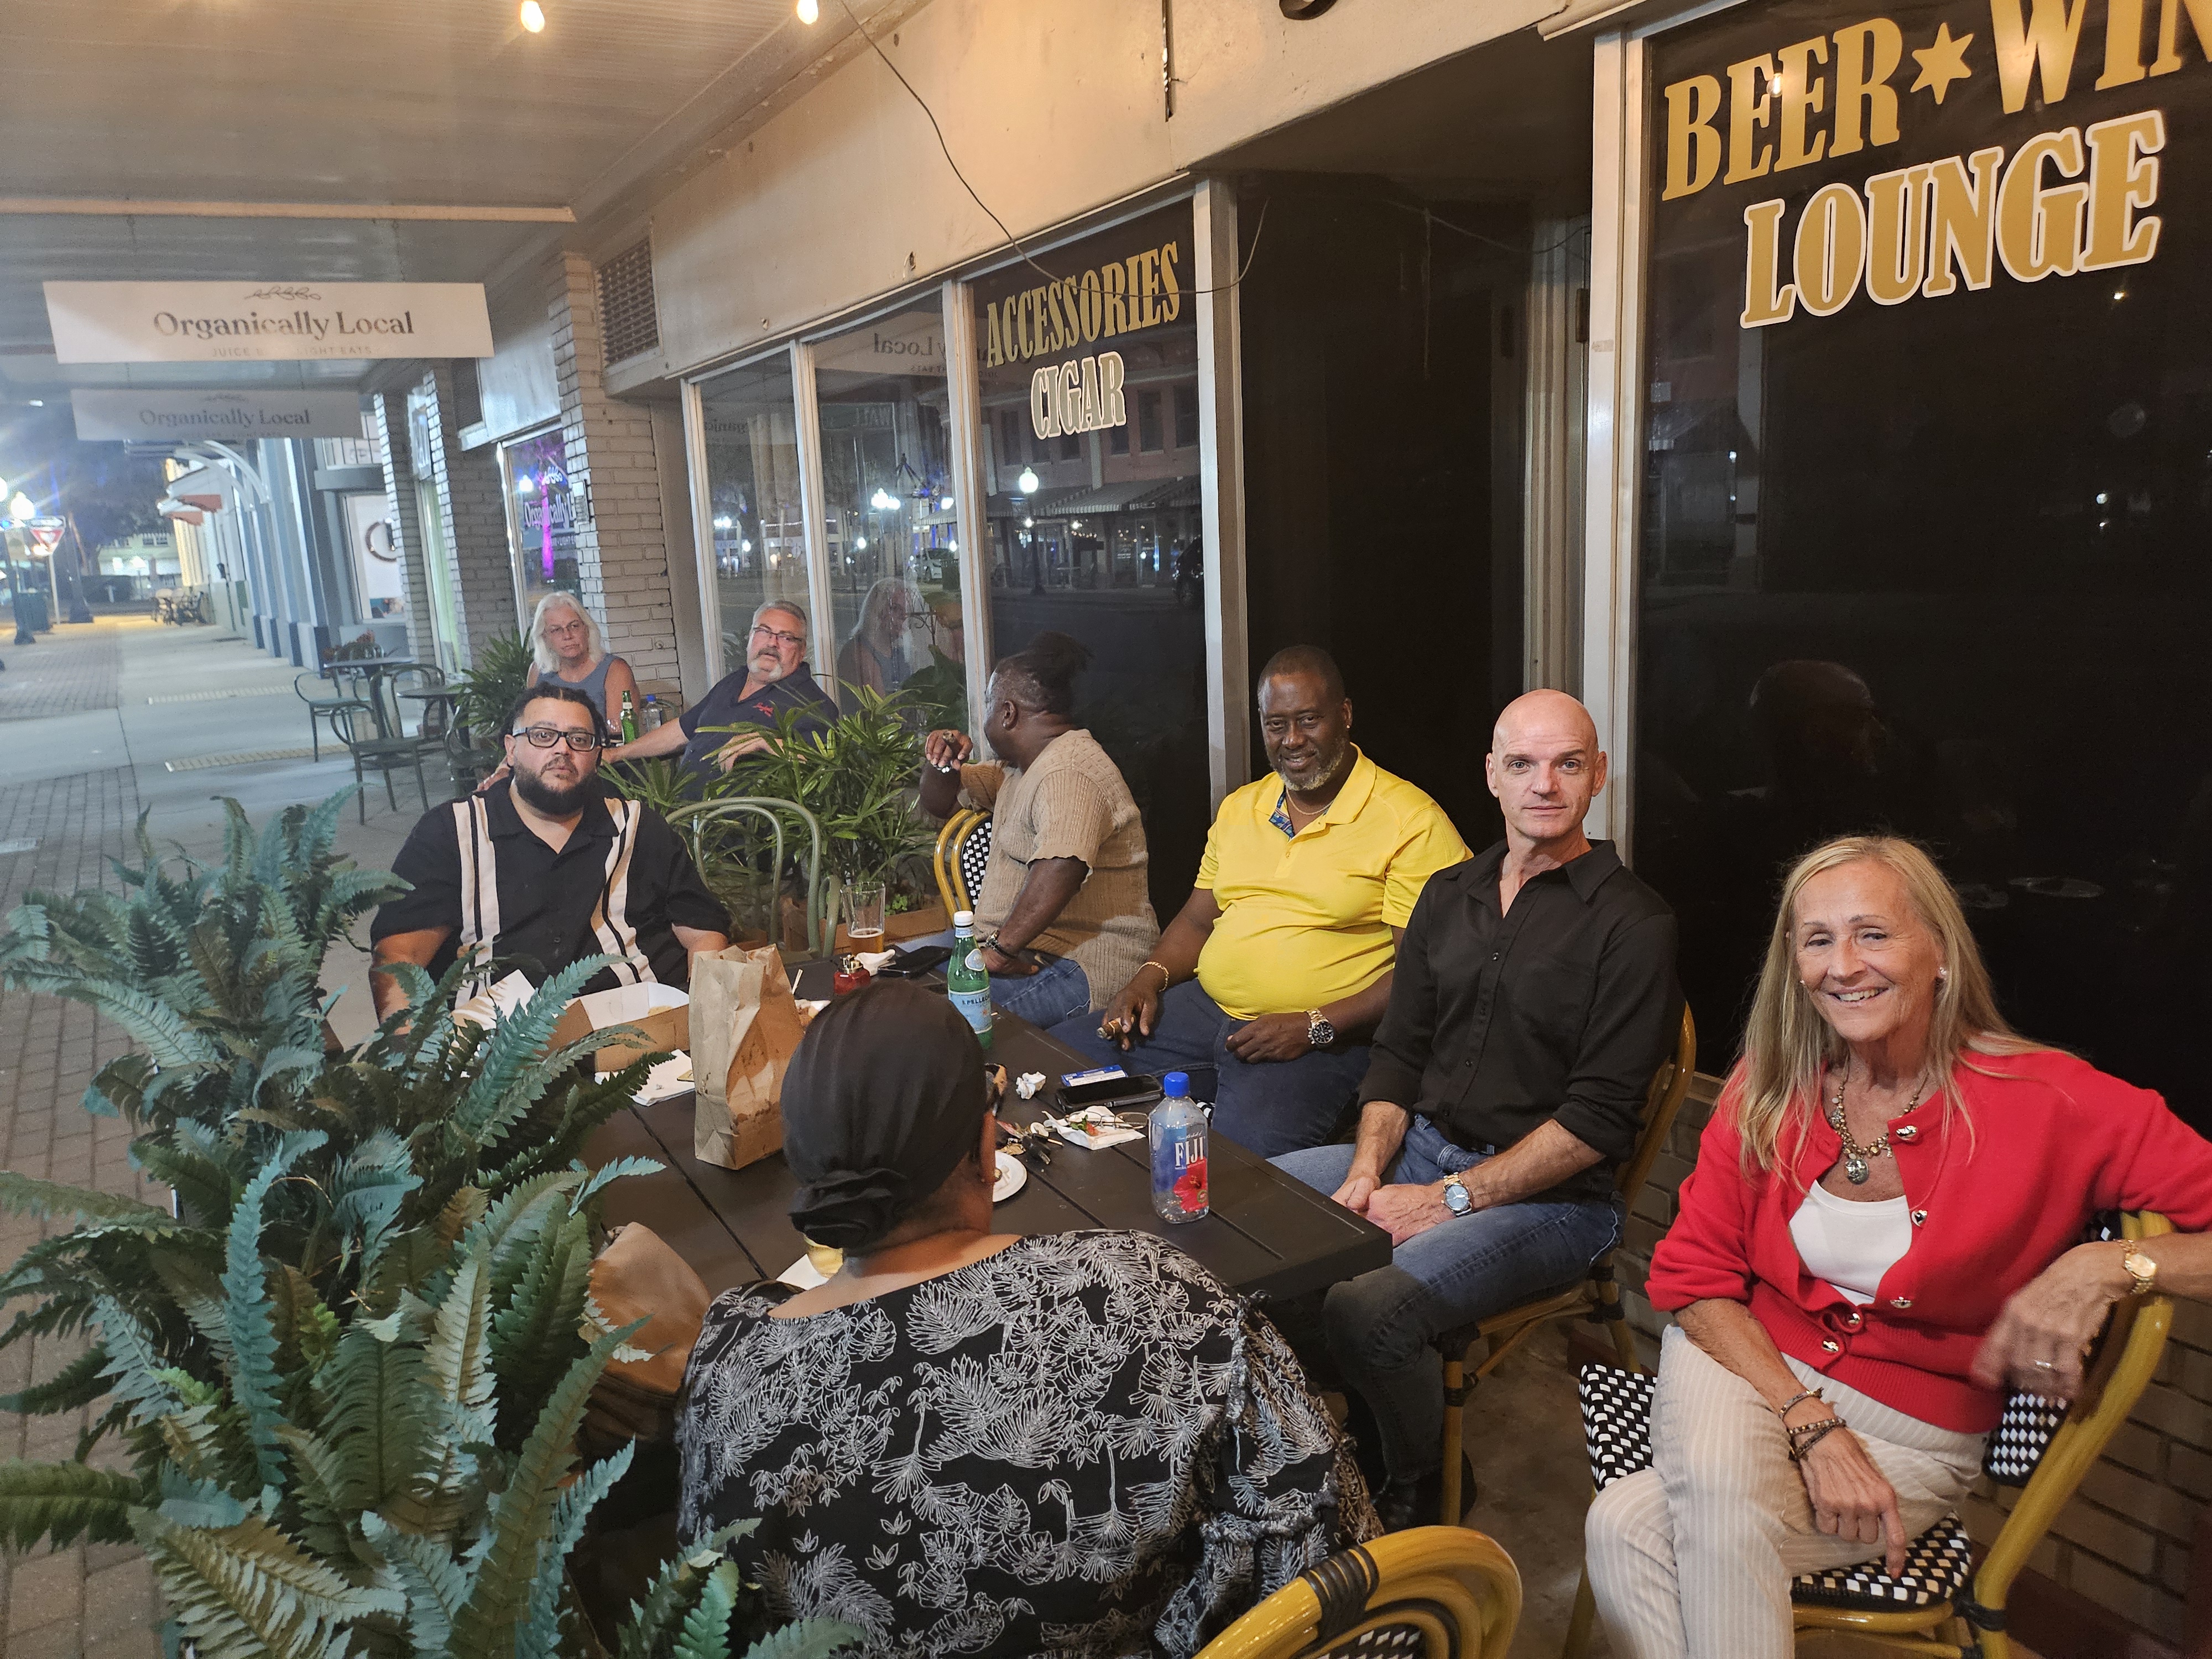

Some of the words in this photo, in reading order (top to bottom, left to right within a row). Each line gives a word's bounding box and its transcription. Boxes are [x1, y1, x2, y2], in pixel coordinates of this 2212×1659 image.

[1662, 18, 1903, 201] BEER
[1740, 110, 2166, 329] LOUNGE
[154, 310, 329, 340] Organically
[338, 310, 414, 336] Local
[987, 241, 1181, 368] ACCESSORIES
[212, 347, 251, 357] JUICE
[340, 346, 373, 355] EATS
[139, 408, 254, 428] Organically
[259, 409, 310, 425] Local
[1030, 351, 1127, 440] CIGAR
[1175, 1136, 1204, 1166] FIJI
